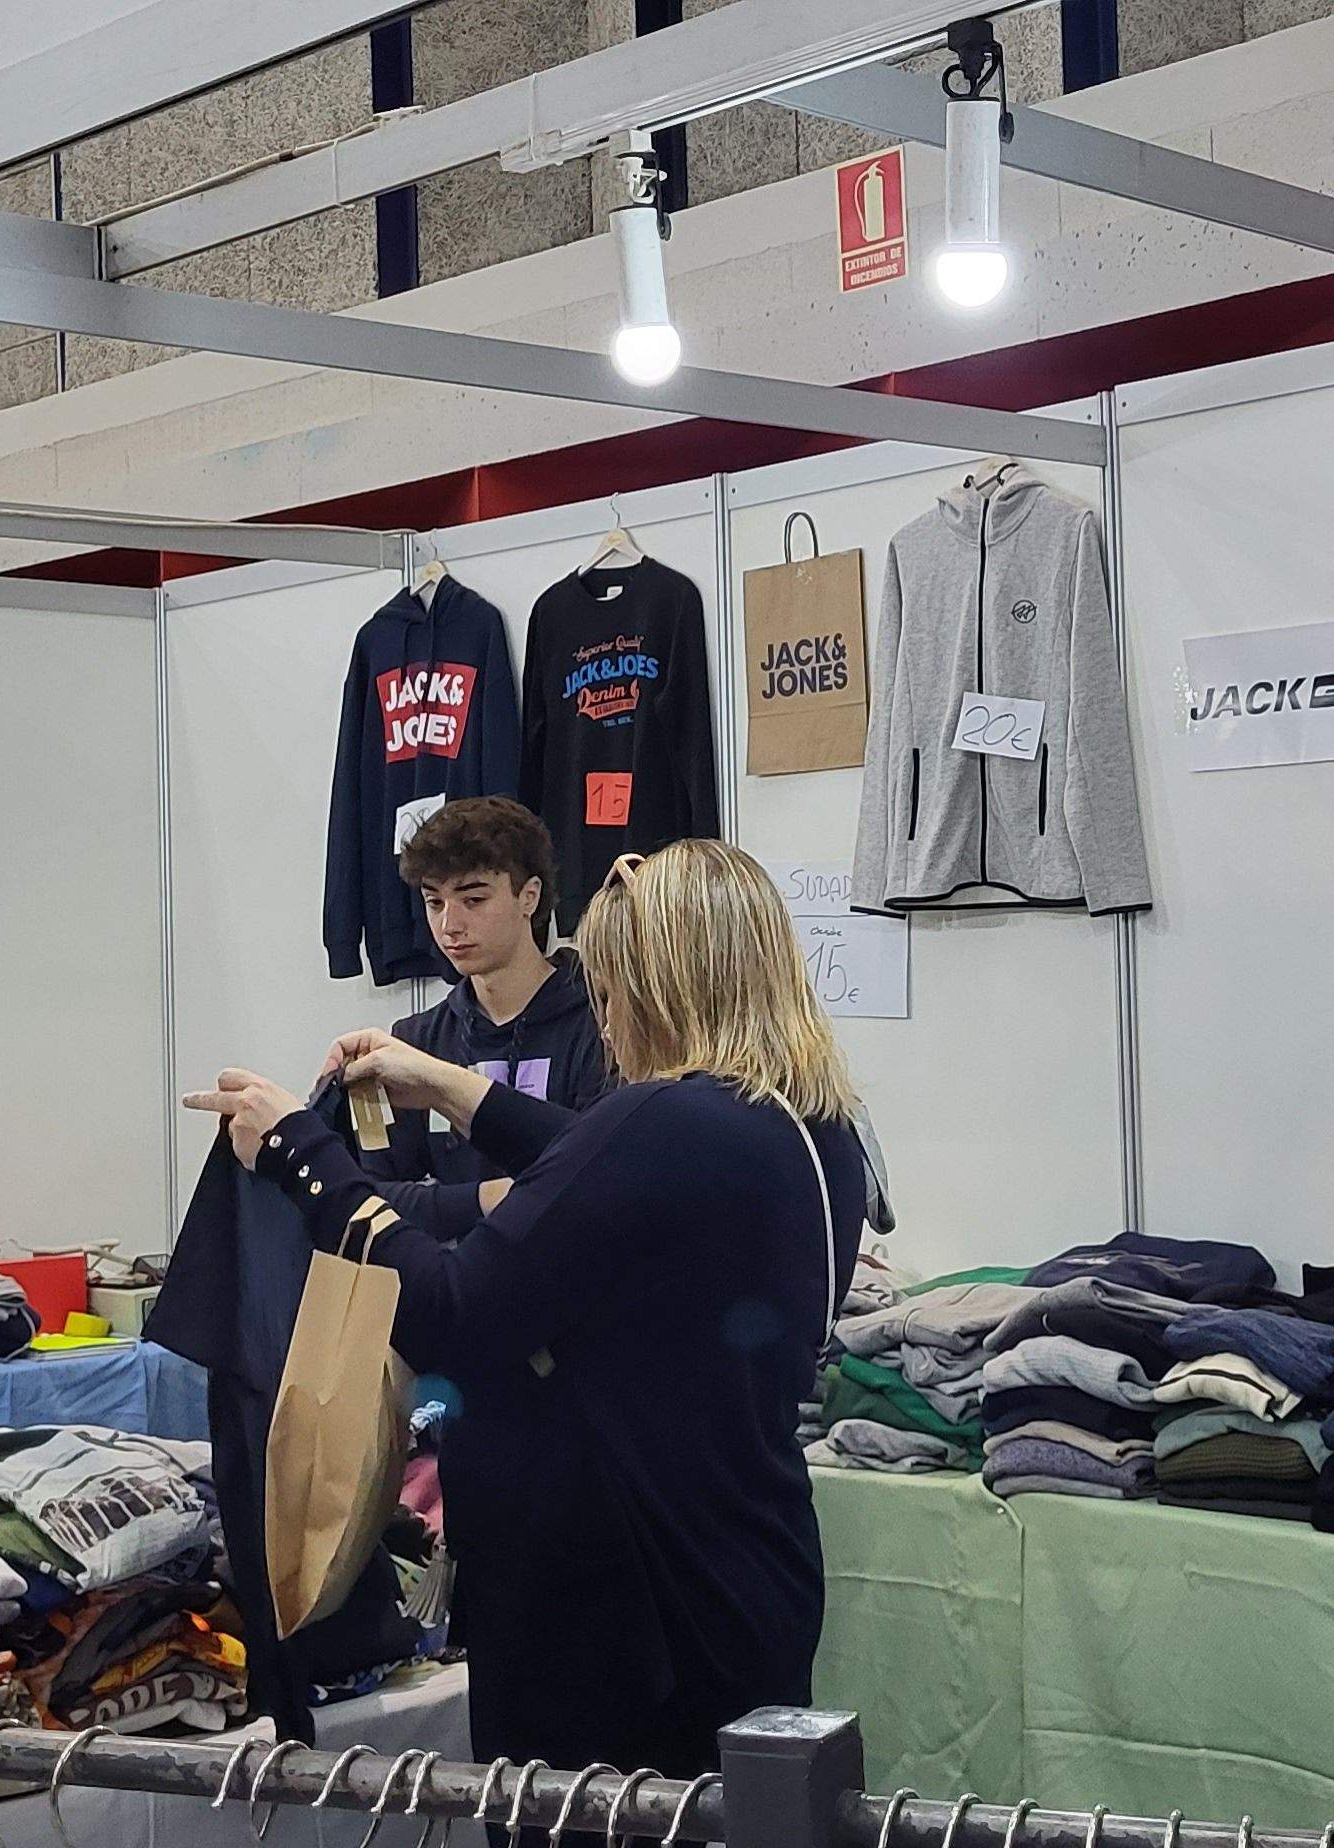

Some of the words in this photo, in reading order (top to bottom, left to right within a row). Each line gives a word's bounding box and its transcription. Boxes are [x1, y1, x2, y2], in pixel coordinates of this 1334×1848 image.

[845, 251, 886, 272] EXTINTOR
[890, 246, 903, 259] DE
[850, 263, 899, 286] INCENDIOS
[760, 633, 847, 671] JACK&
[385, 670, 465, 712] JACK&
[761, 662, 848, 699] JONES
[1190, 677, 1307, 722] JACK
[386, 712, 458, 752] JOES
[962, 706, 1032, 752] 20€
[591, 782, 629, 819] 15
[784, 868, 852, 903] SUDAD
[806, 941, 860, 1003] 15€
